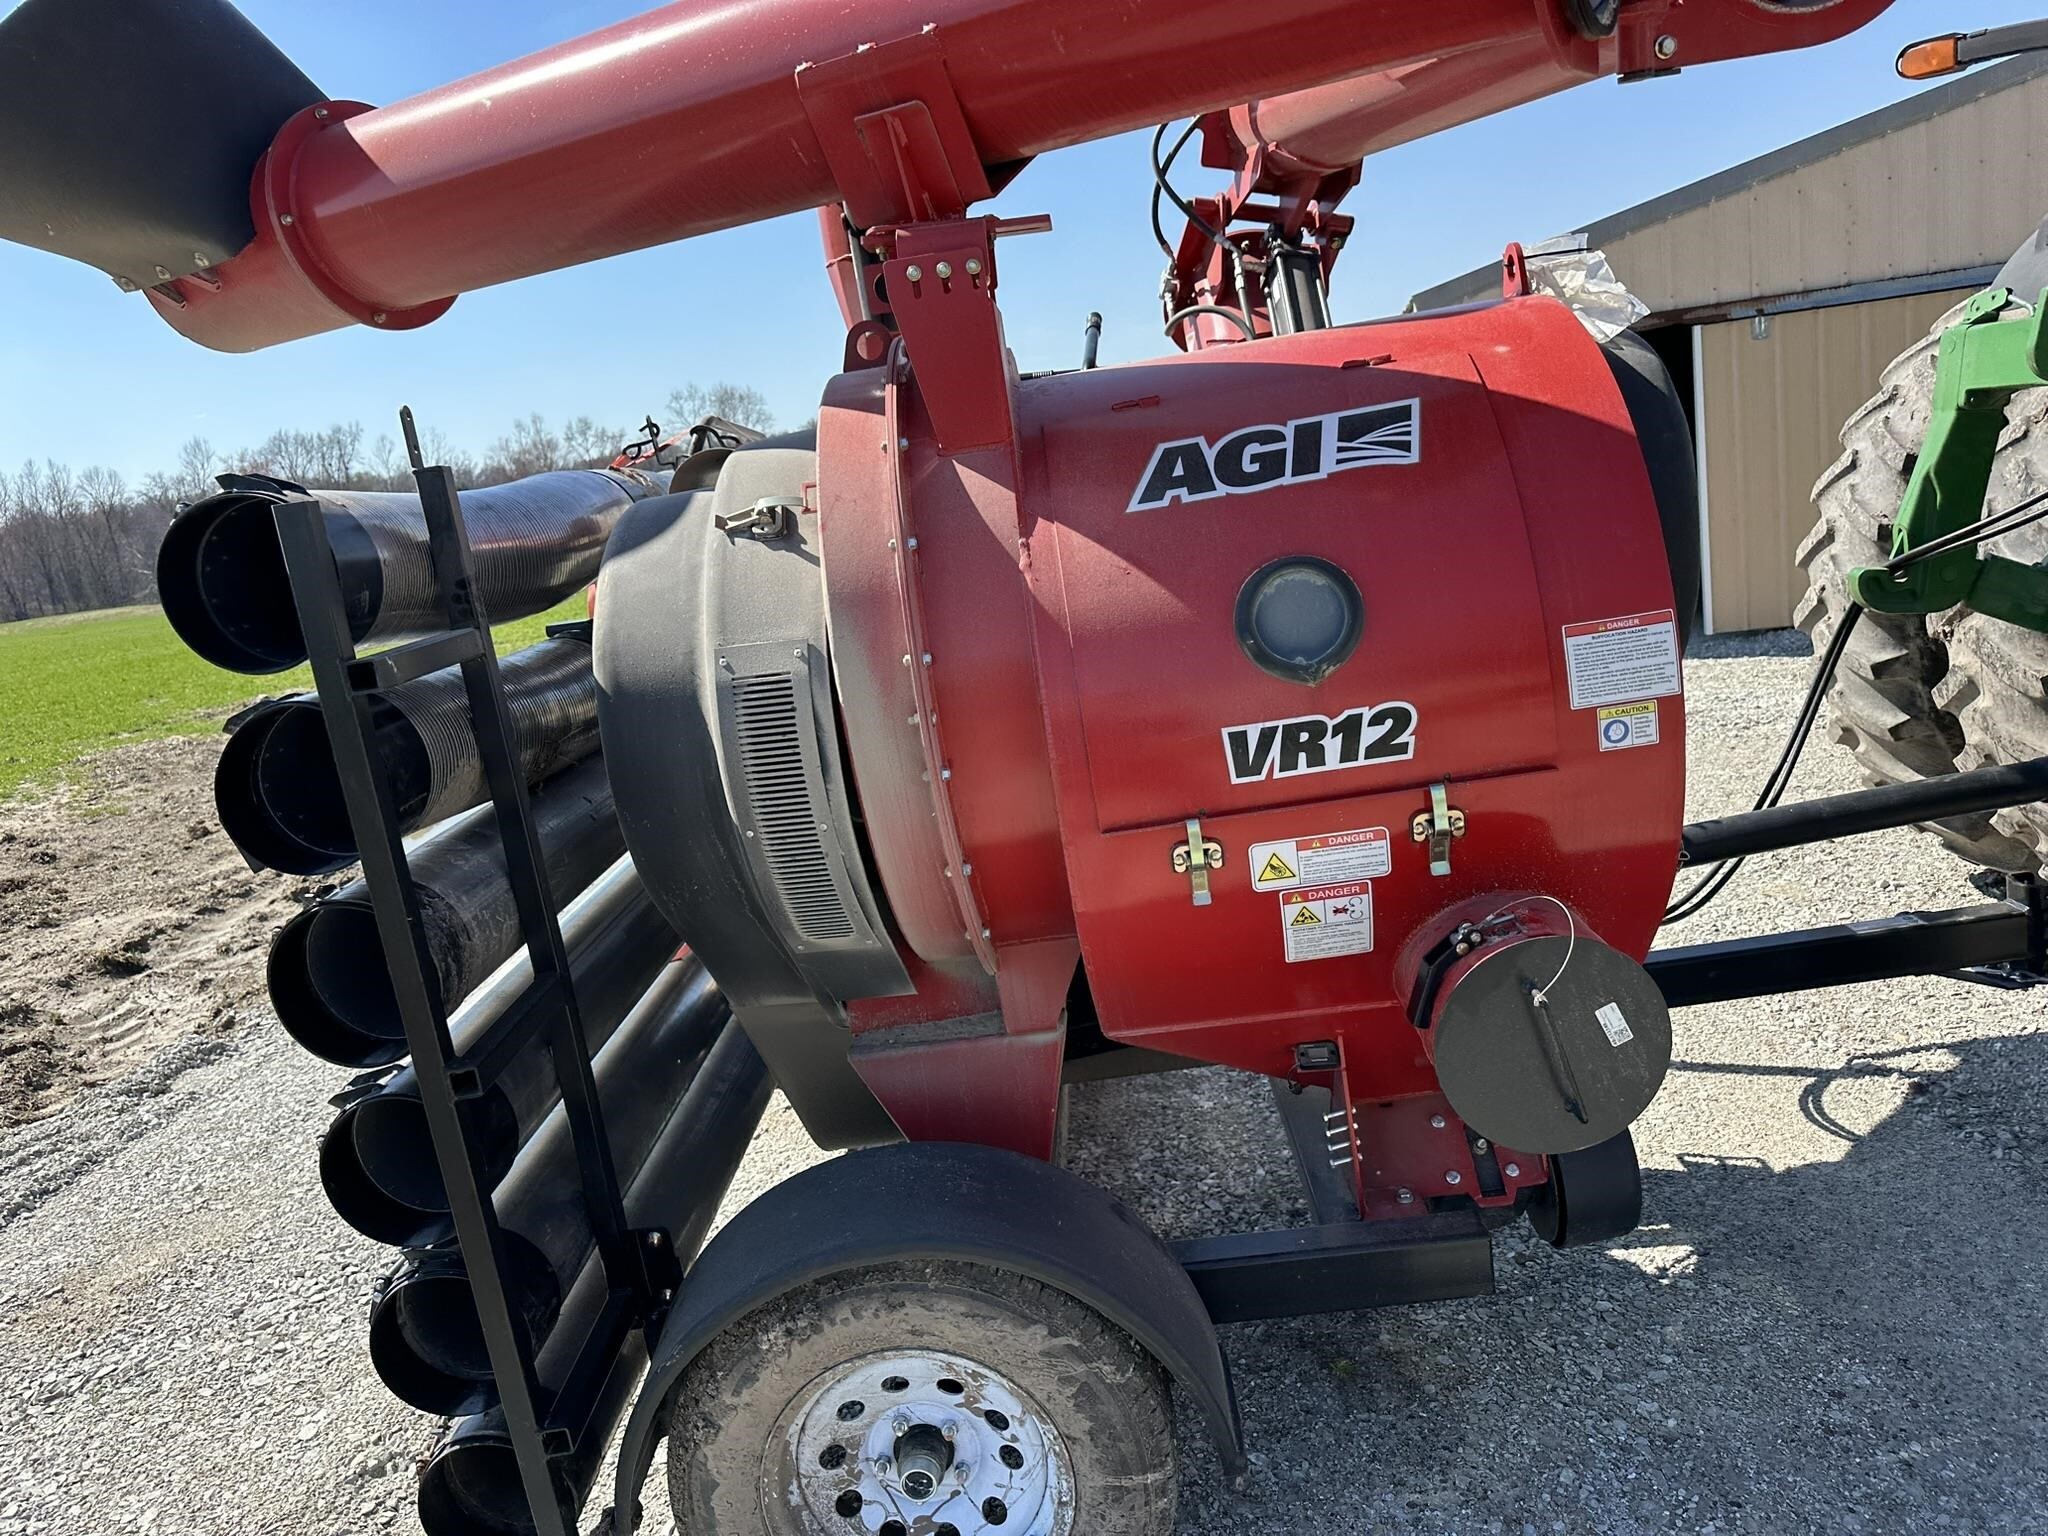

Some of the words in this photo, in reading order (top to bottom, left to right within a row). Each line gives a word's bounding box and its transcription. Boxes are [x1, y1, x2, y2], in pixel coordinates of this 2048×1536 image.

[1138, 420, 1323, 505] AGI
[1606, 618, 1640, 629] DANGER
[1615, 705, 1649, 715] CAUTION
[1228, 706, 1412, 779] VR12
[1328, 832, 1374, 845] DANGER
[1308, 886, 1360, 900] DANGER
